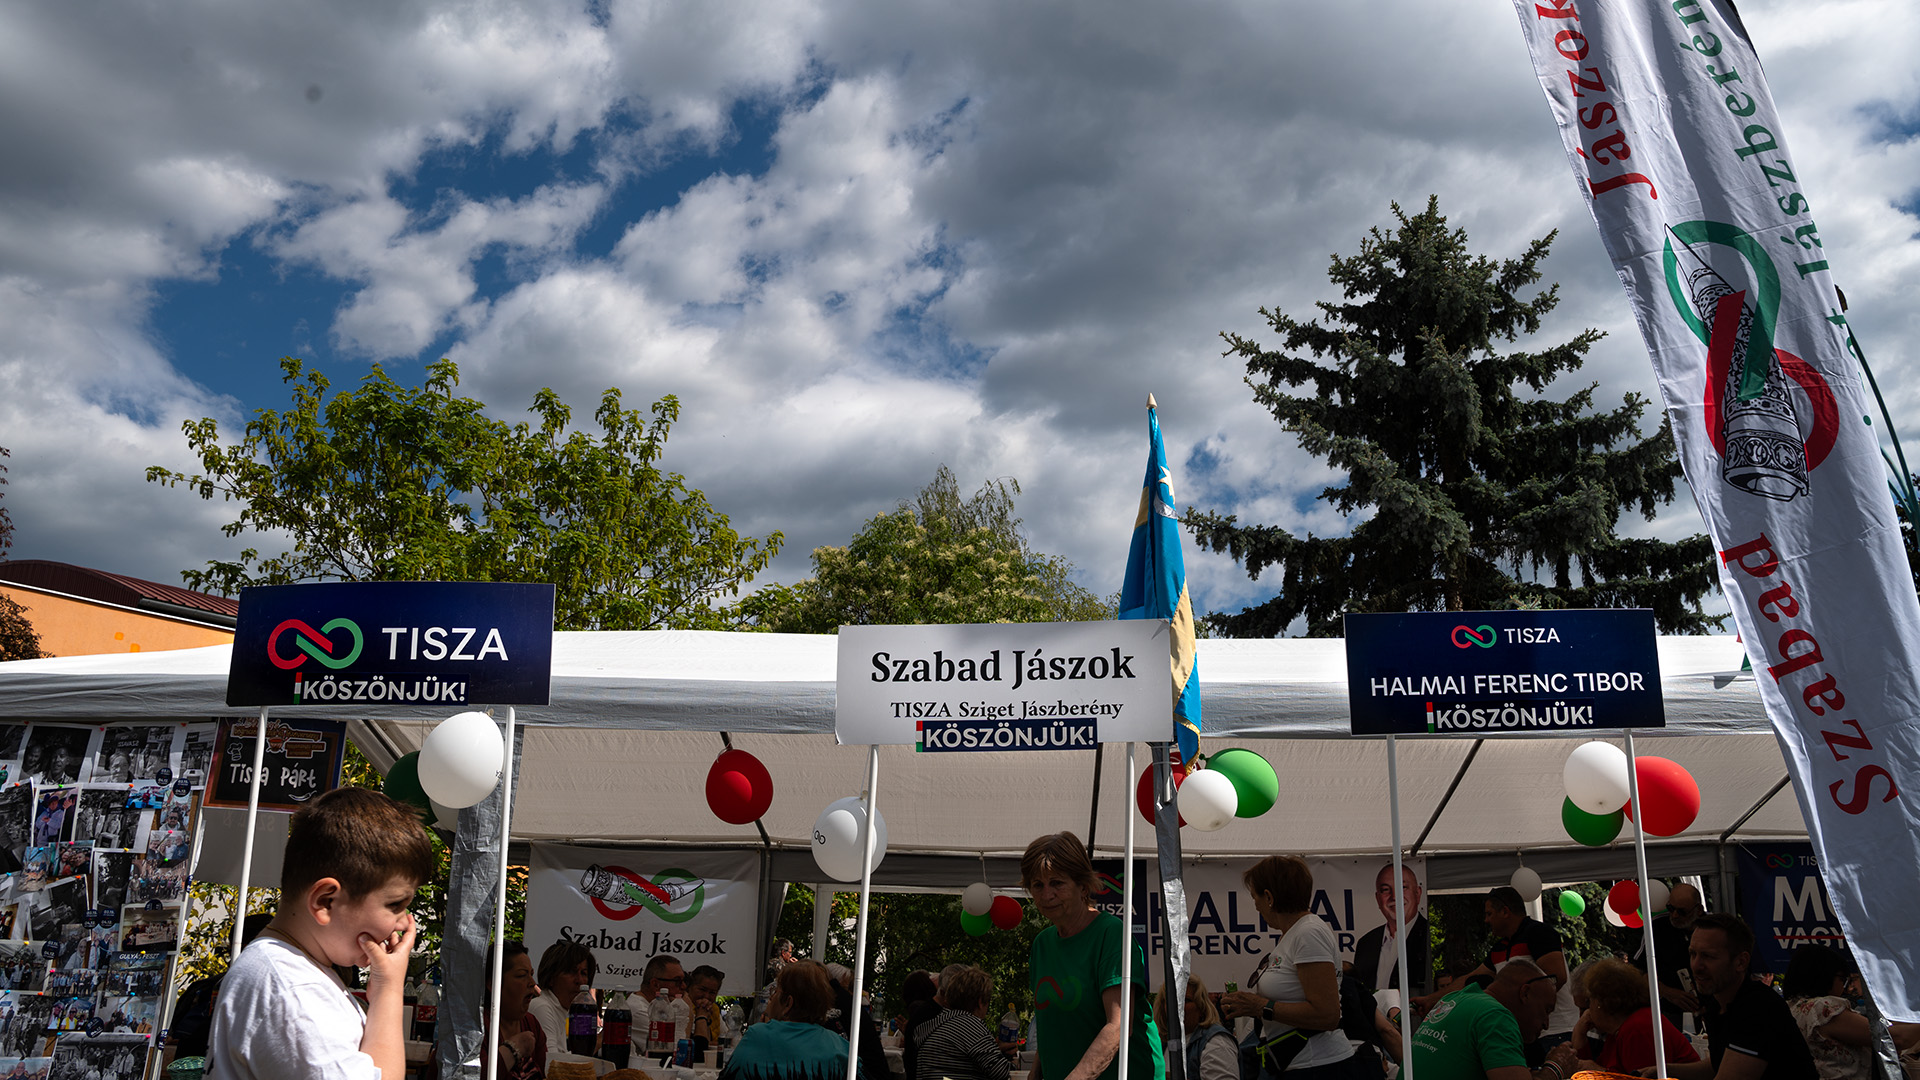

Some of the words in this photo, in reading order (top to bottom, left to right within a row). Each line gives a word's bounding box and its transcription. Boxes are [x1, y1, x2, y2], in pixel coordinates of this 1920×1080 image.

[1672, 0, 1829, 281] Jászberén
[382, 626, 509, 661] TISZA
[1504, 628, 1560, 644] TISZA
[871, 650, 1002, 682] Szabad
[1011, 647, 1136, 690] Jászok
[1720, 532, 1899, 815] Szabad
[303, 675, 466, 702] KÖSZÖNJÜK!
[1371, 676, 1466, 696] HALMAI
[1474, 674, 1568, 694] FERENC
[1573, 672, 1645, 692] TIBOR
[890, 701, 952, 718] TISZA
[959, 701, 1015, 721] Sziget
[1018, 700, 1124, 720] Jászberény
[1436, 701, 1594, 729] KÖSZÖNJÜK!
[925, 721, 1094, 748] KÖSZÖNJÜK!
[230, 763, 270, 786] Tisa
[1798, 855, 1818, 866] TIS
[1150, 889, 1354, 934] ALAI
[1773, 876, 1838, 921] M
[559, 926, 642, 951] Szabad
[645, 932, 726, 958] Jászok
[1152, 934, 1262, 955] FRENC
[1773, 926, 1846, 949] VAGY
[606, 964, 645, 979] Sziget
